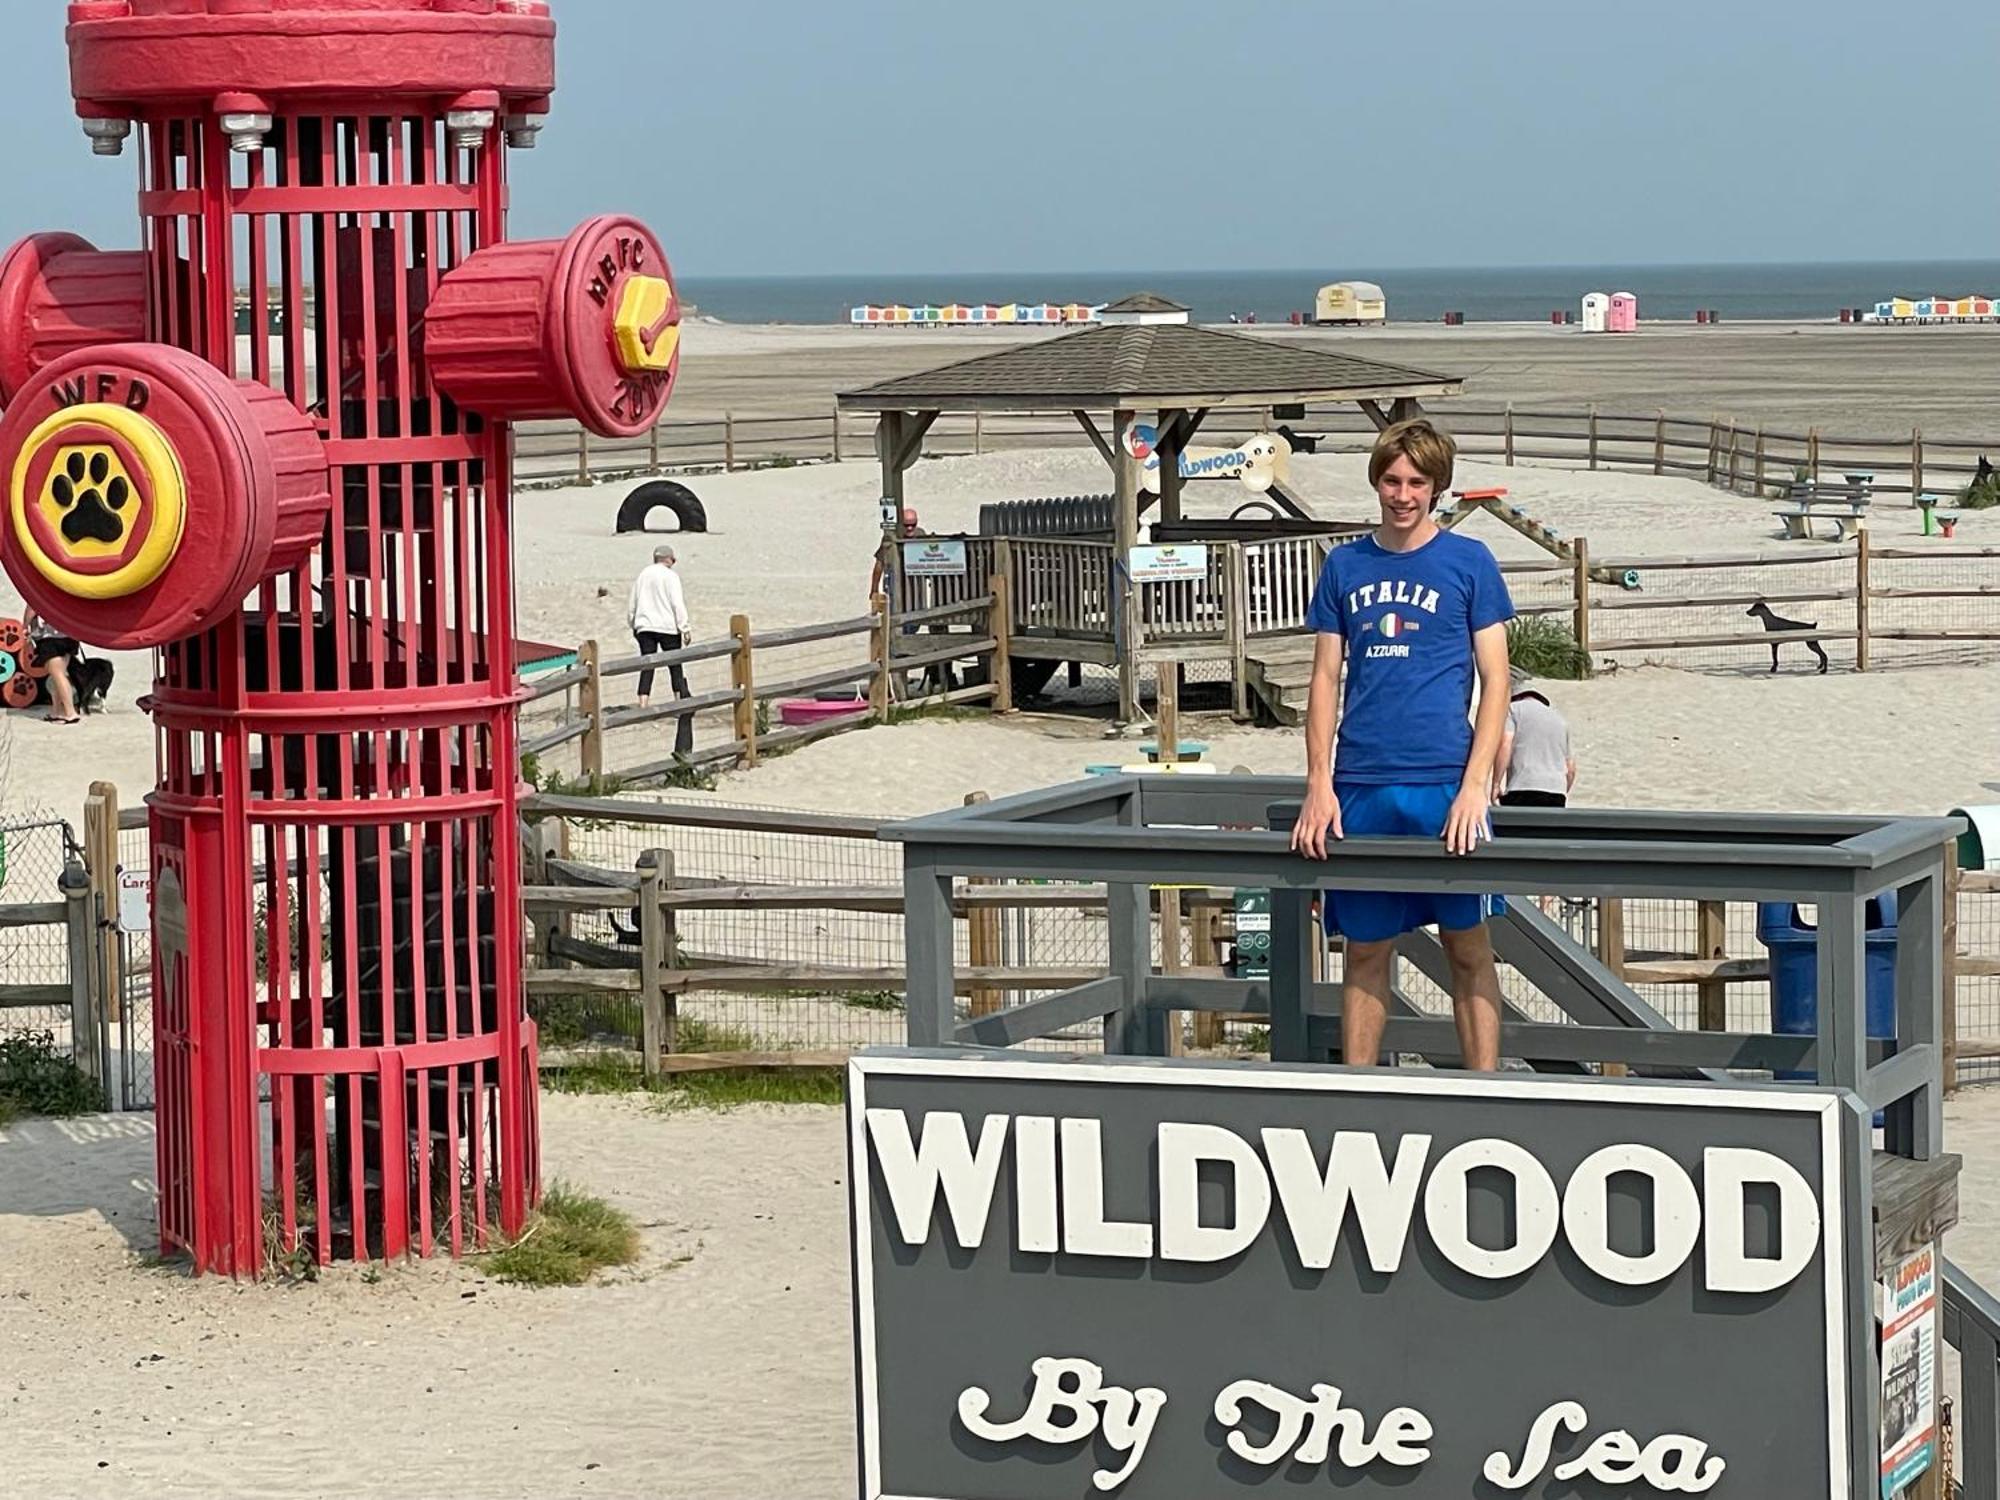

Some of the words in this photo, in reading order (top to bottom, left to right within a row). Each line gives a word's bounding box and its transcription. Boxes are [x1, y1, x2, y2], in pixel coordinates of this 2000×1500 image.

[50, 373, 150, 413] WFD
[1349, 580, 1440, 615] ITALIA
[1365, 644, 1410, 659] AZZURRI
[122, 879, 151, 890] Larg
[865, 1107, 1821, 1294] WILDWOOD
[957, 1356, 1168, 1491] By
[1213, 1379, 1434, 1468] The
[1482, 1400, 1727, 1494] Sea
